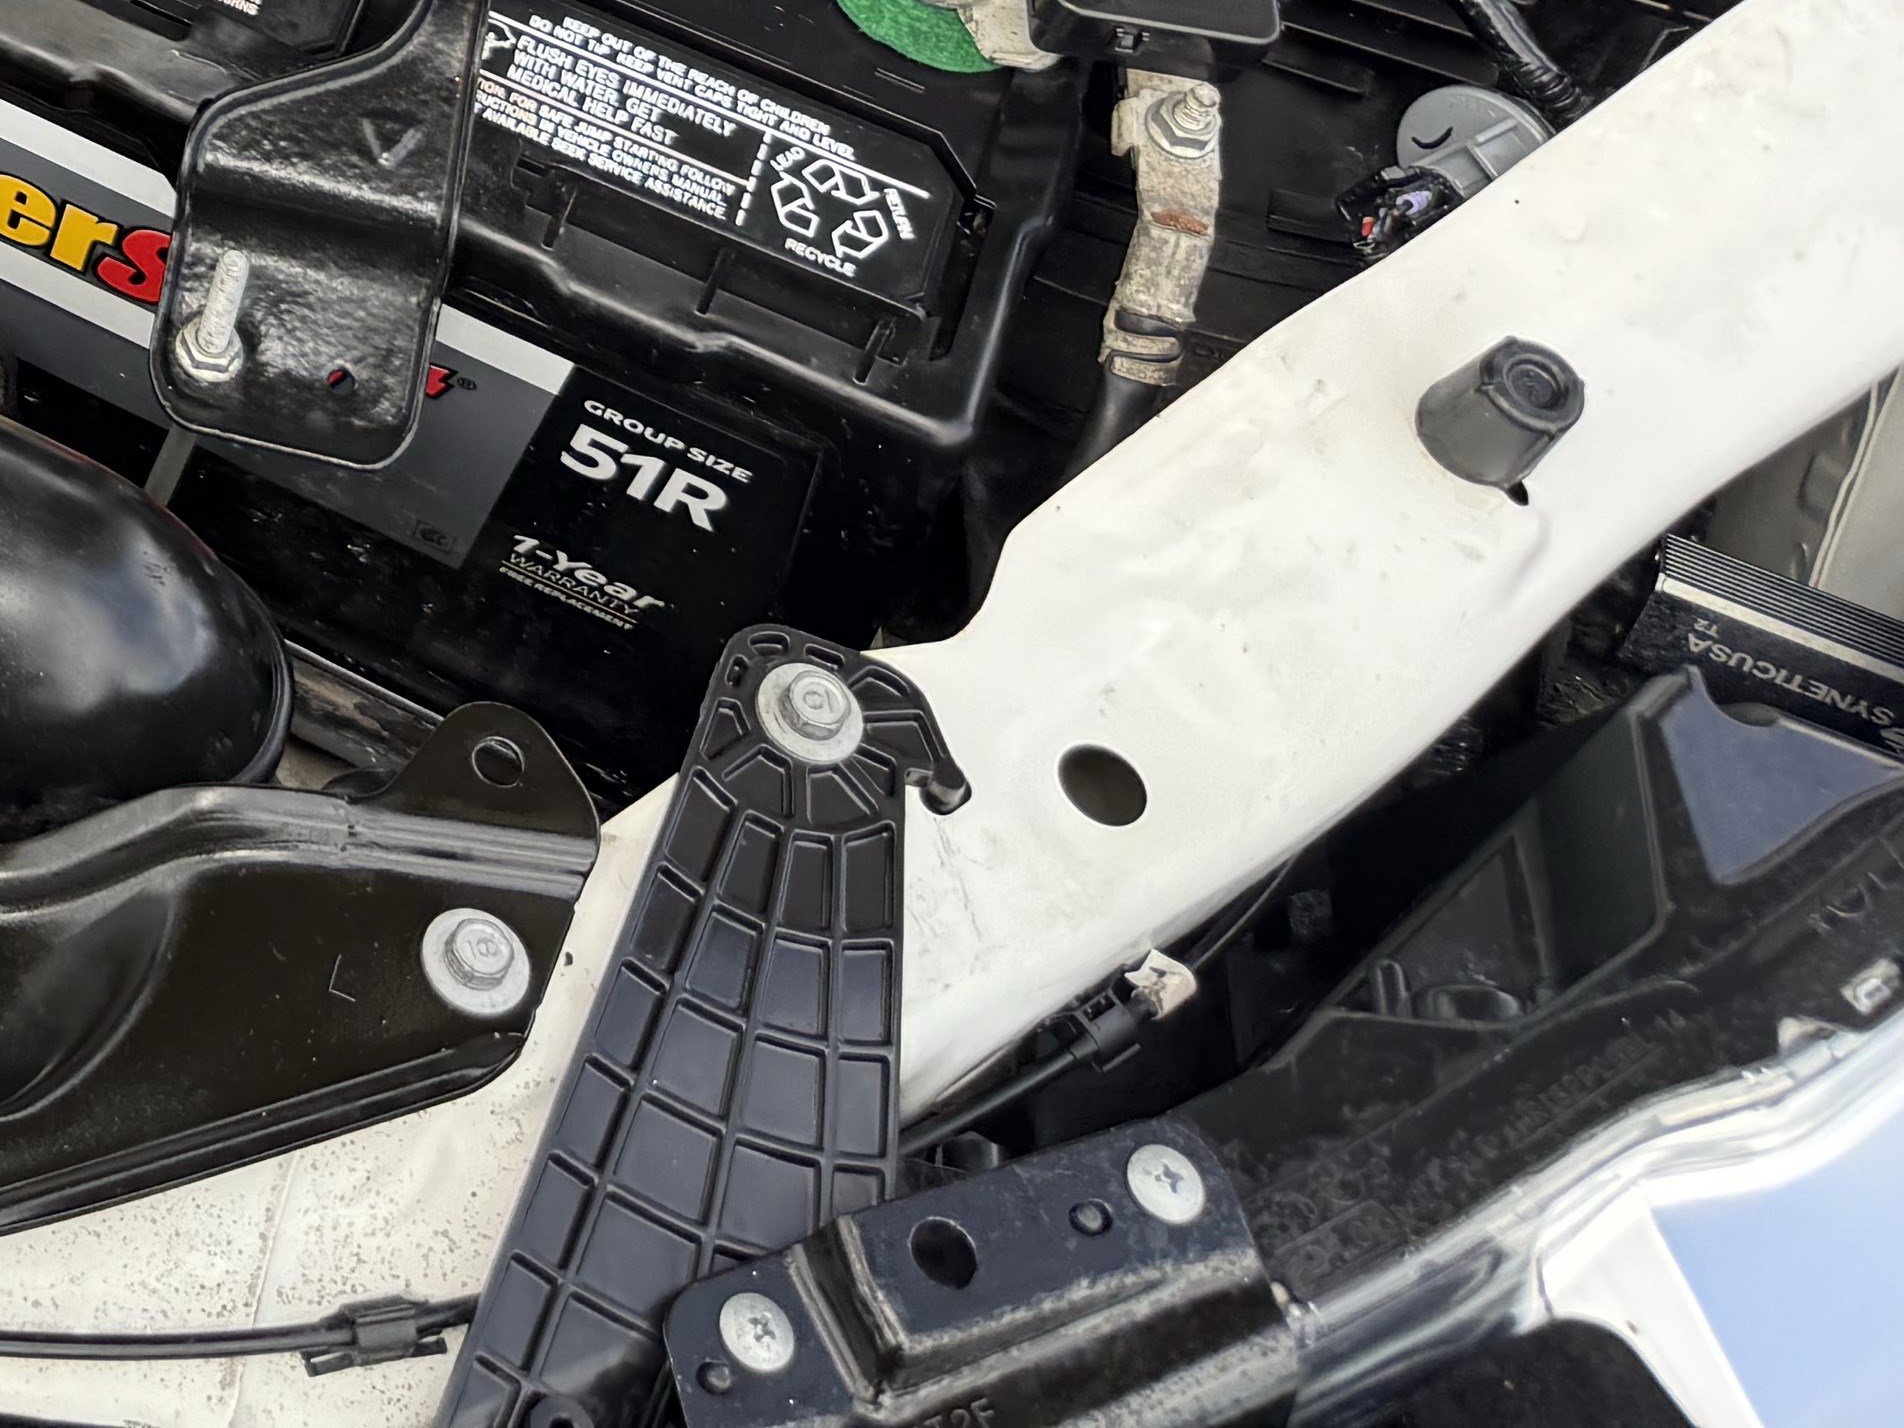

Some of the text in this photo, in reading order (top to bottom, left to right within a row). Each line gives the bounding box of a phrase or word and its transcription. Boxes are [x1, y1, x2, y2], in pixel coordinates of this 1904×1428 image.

[506, 63, 580, 108] MEDICAL
[582, 96, 630, 126] HELP
[631, 114, 680, 146] FAST
[513, 50, 559, 78] WITH
[624, 95, 662, 122] GET
[516, 35, 737, 138] FLUSH EYES IMMEDIATELY
[528, 15, 553, 33] DO
[553, 25, 584, 45] NOT
[616, 52, 654, 75] KEEP
[656, 67, 692, 91] VENT
[693, 84, 734, 108] CAPS
[736, 98, 778, 126] TIGHT
[779, 118, 813, 141] AND
[562, 16, 831, 137] KEEP OUT OF THE REACH OF CHILDREN
[538, 104, 576, 128] SAFE
[575, 119, 614, 141] JUMP
[613, 134, 680, 171] STARTING
[680, 161, 736, 195] FOLLOW
[556, 124, 612, 157] VEHICLE
[588, 152, 644, 186] SERVICE
[784, 236, 858, 278] RECYCLE
[560, 423, 729, 533] 51R
[583, 399, 754, 484] GROUP SIZE
[499, 566, 636, 630] FREE REPLACEMENT
[509, 552, 640, 616] WARRANTY
[511, 534, 666, 610] 1-Year
[1694, 617, 1720, 640] T2
[1687, 632, 1894, 727] SYNETICUSA
